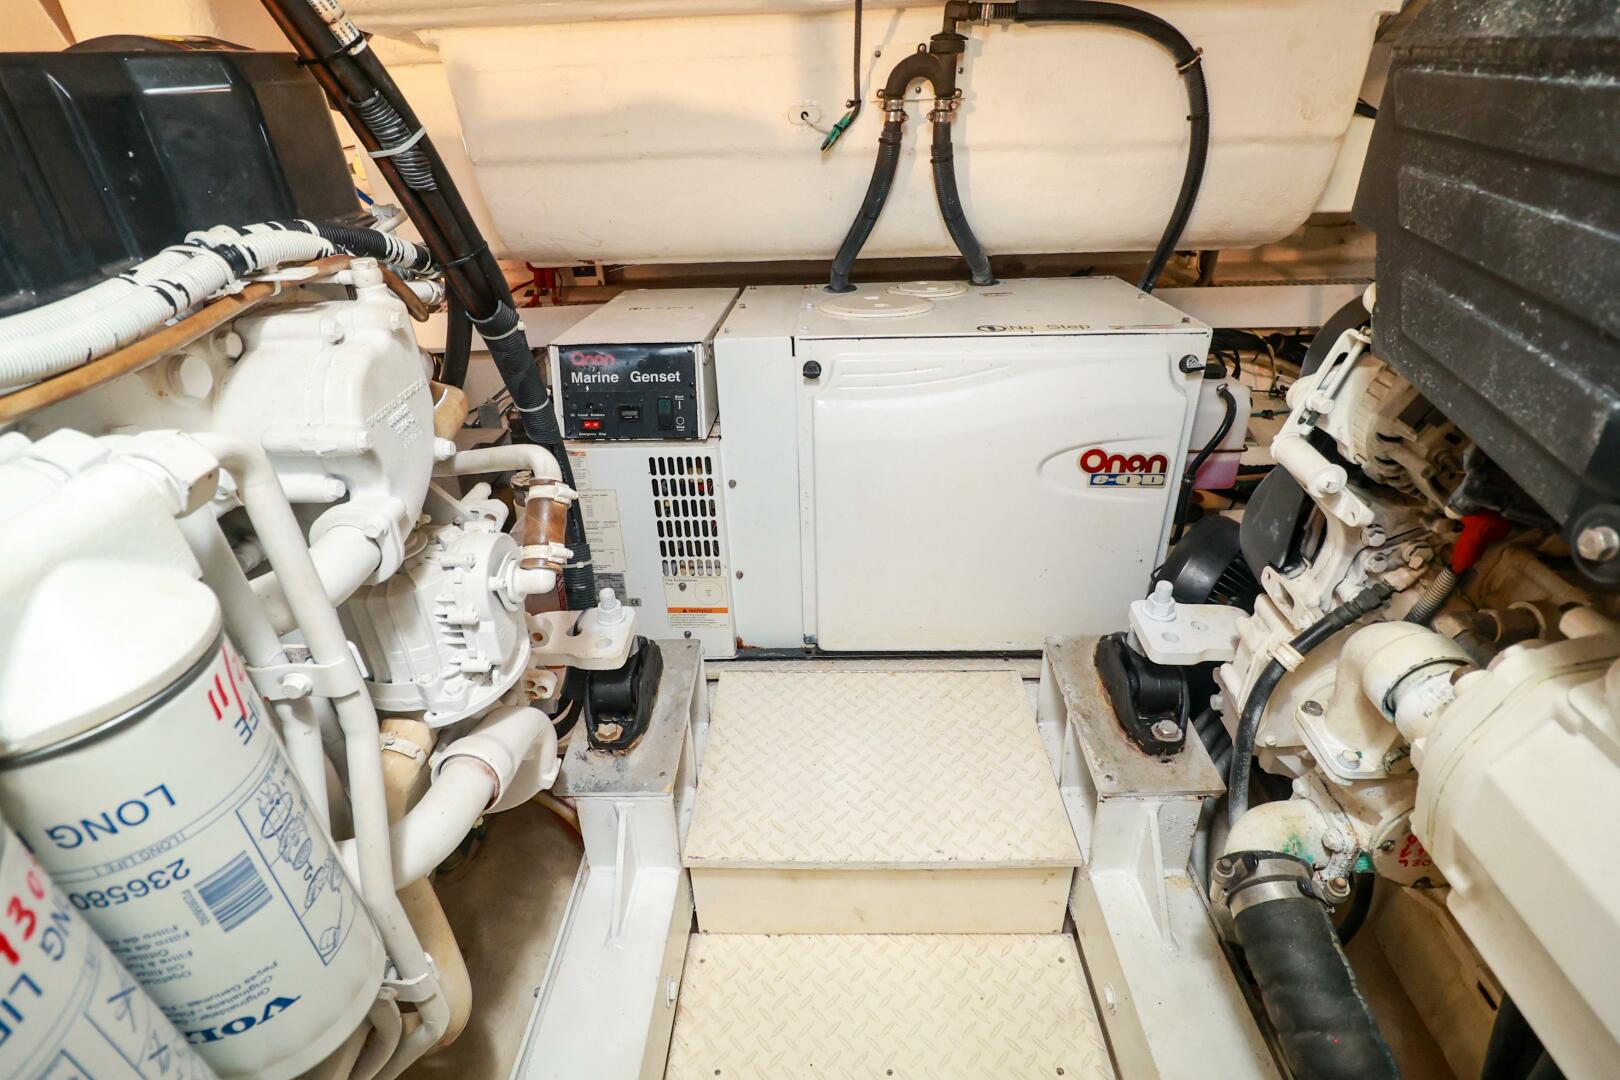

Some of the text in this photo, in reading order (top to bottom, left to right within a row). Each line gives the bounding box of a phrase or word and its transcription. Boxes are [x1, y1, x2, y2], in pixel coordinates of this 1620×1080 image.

[571, 370, 681, 384] Marine Genset
[1080, 448, 1168, 473] Onan
[45, 784, 176, 849] LONG
[68, 858, 190, 911] 236580
[184, 994, 302, 1045] VOL
